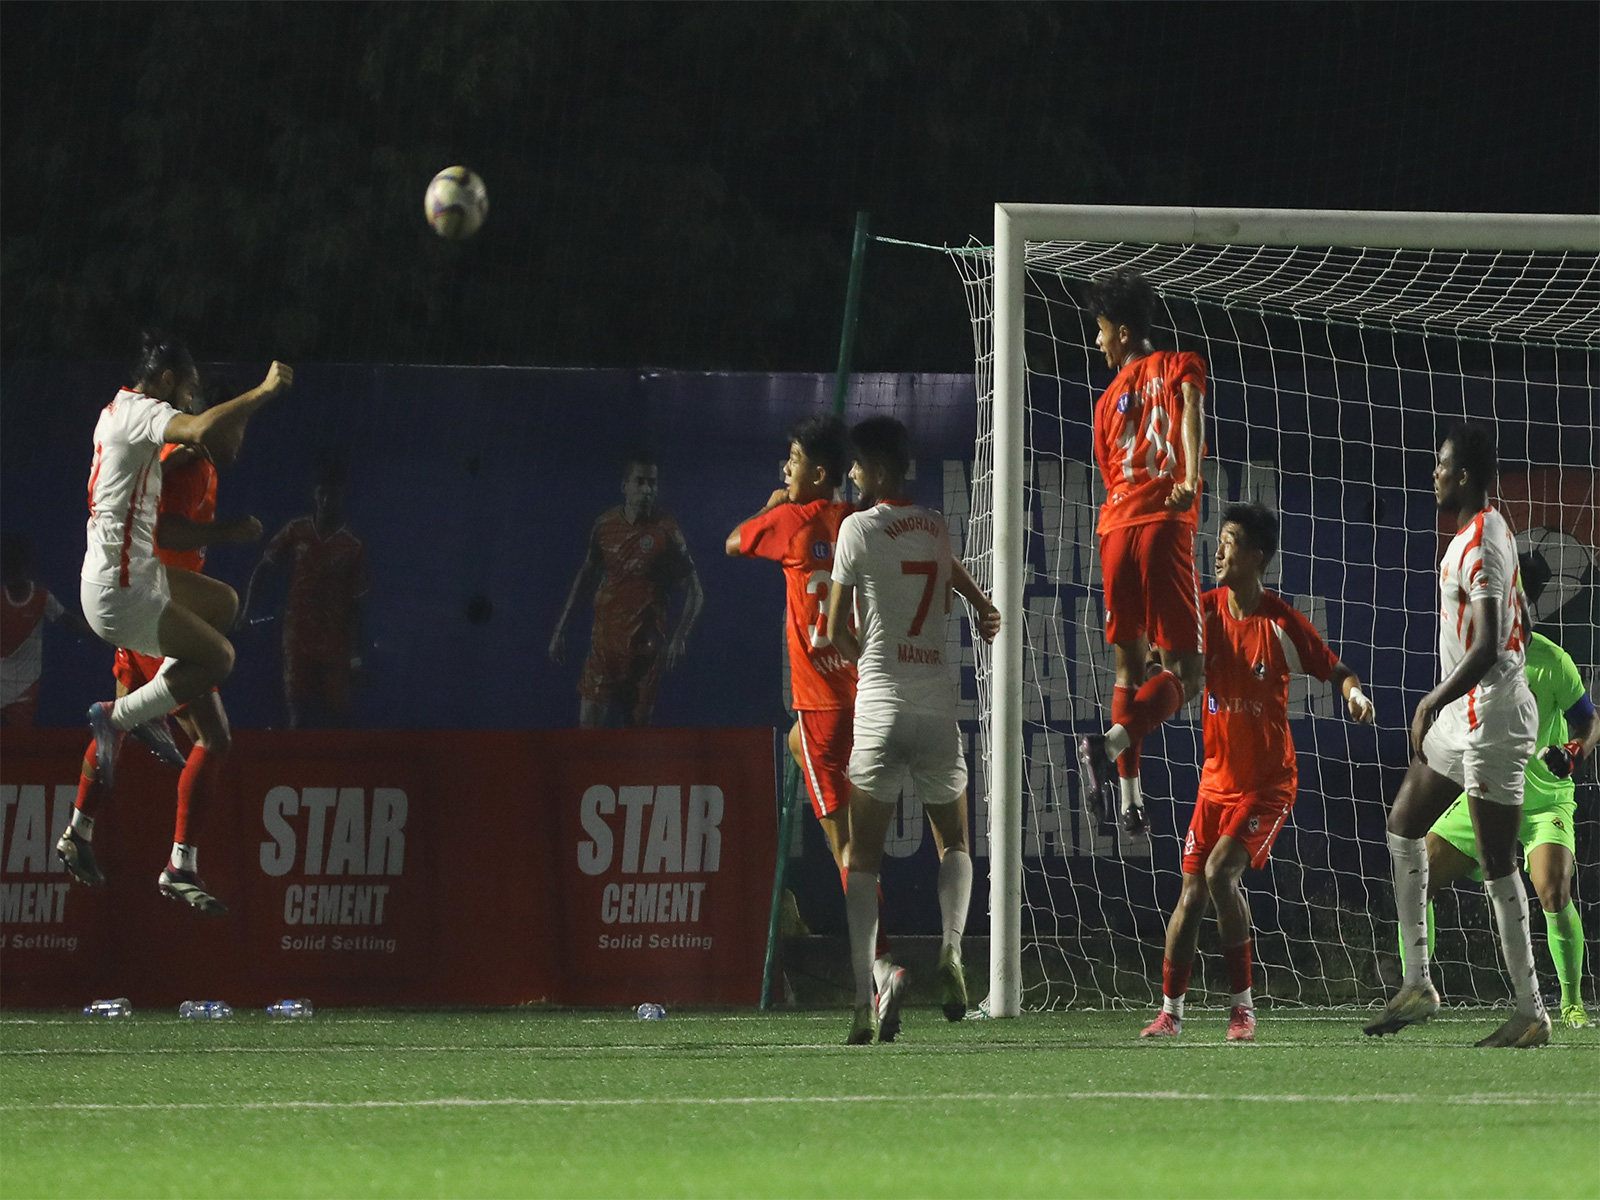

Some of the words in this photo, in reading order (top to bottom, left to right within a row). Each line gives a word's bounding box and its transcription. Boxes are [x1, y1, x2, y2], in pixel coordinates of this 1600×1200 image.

[1116, 405, 1177, 483] 18
[900, 560, 938, 637] 7
[259, 785, 409, 877] STAR
[576, 784, 725, 876] STAR
[283, 884, 390, 926] CEMENT
[601, 882, 706, 924] CEMENT
[12, 934, 78, 952] Setting
[281, 935, 326, 951] Solid
[331, 935, 396, 953] Setting
[598, 934, 643, 949] Solid
[648, 933, 713, 951] Setting
